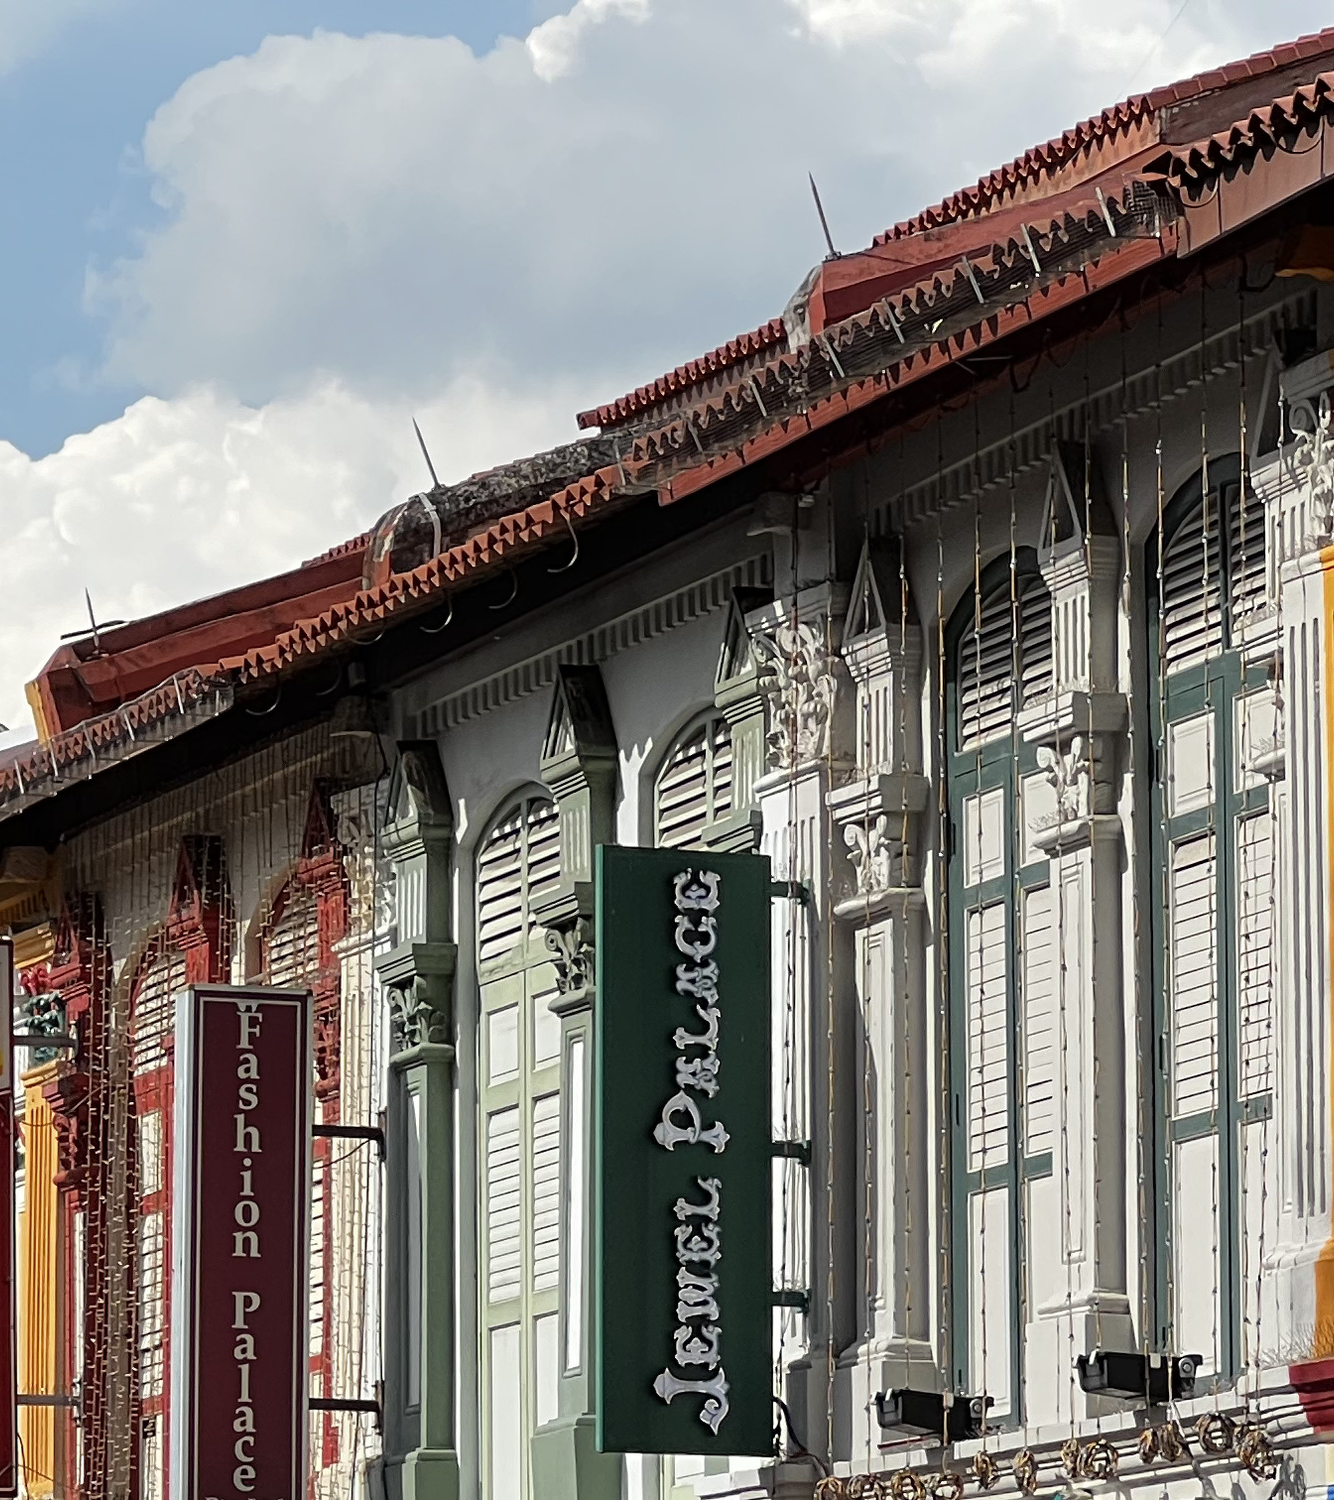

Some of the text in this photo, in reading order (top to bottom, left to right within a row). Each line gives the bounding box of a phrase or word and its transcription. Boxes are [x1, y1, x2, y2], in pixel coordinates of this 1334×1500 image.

[232, 1013, 262, 1491] Fashion Palace
[653, 1174, 729, 1436] JEWEL
